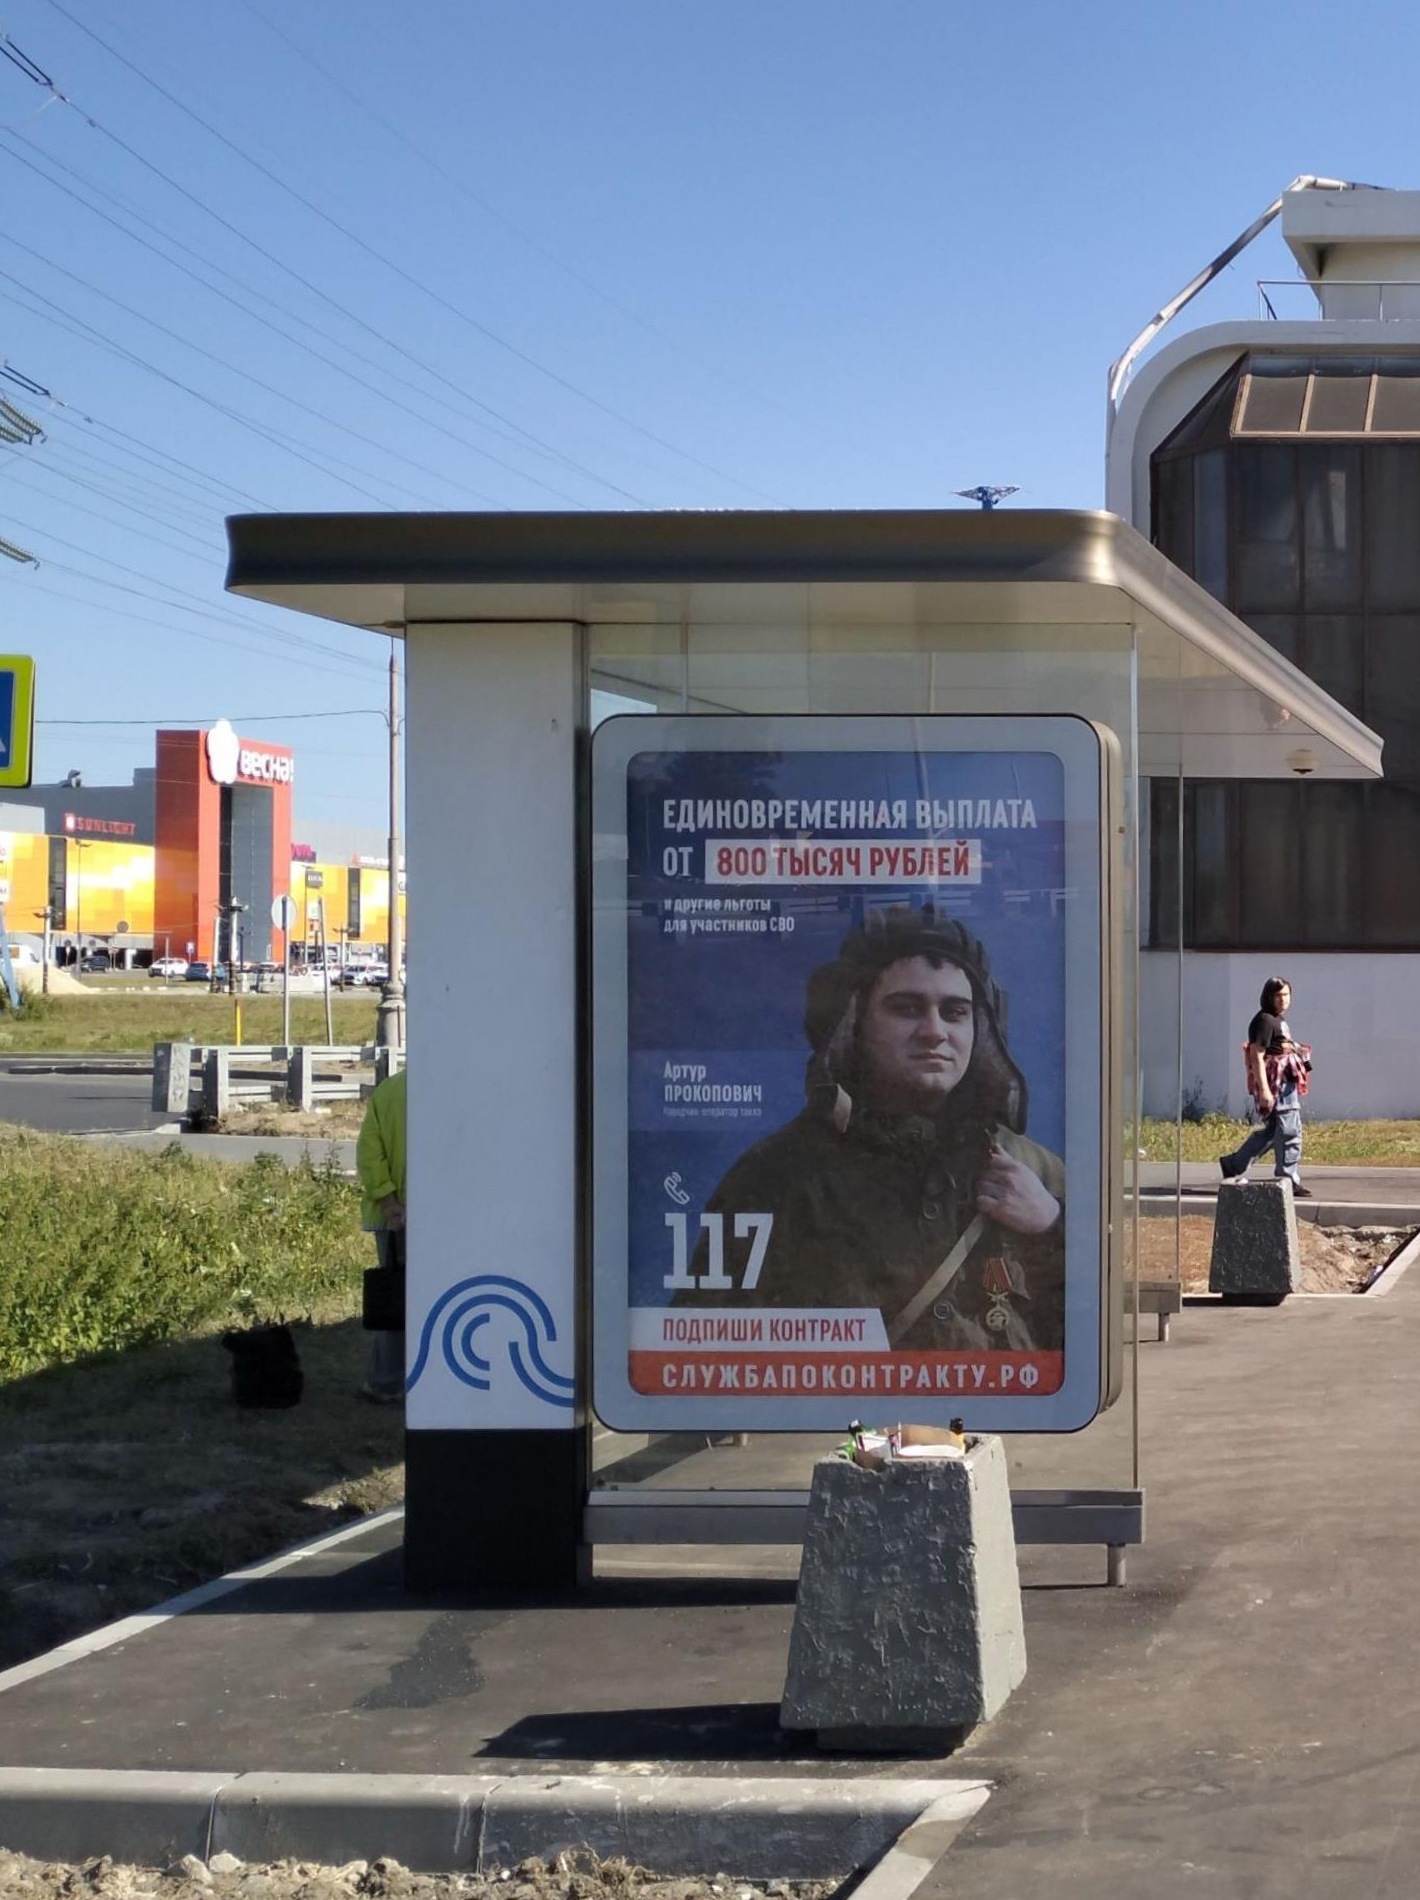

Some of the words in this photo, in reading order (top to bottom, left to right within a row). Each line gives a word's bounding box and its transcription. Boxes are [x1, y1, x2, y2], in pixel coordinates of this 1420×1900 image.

[663, 799, 907, 832] ЕДИНОВРЕМЕННАЯ
[916, 799, 1037, 829] ВЫПЛАТА
[663, 846, 693, 877] ОТ
[717, 846, 767, 876] 800
[773, 846, 861, 876] ТЫСЯЧ
[870, 839, 969, 876] РУБЛЕЙ
[674, 899, 721, 914] другие
[723, 899, 771, 911] льготы
[664, 920, 687, 933] для
[690, 920, 767, 935] участников
[769, 917, 795, 932] СВО
[664, 1061, 706, 1082] Артур
[664, 1084, 762, 1102] ПРОКОПОВИЧ
[663, 1213, 774, 1289] 117
[663, 1319, 763, 1343] ПОДПИШИ
[769, 1319, 866, 1342] КОНТРАКТ
[662, 1363, 1040, 1389] СЛУЖБАПОКОНТРАКТУ.РФ
